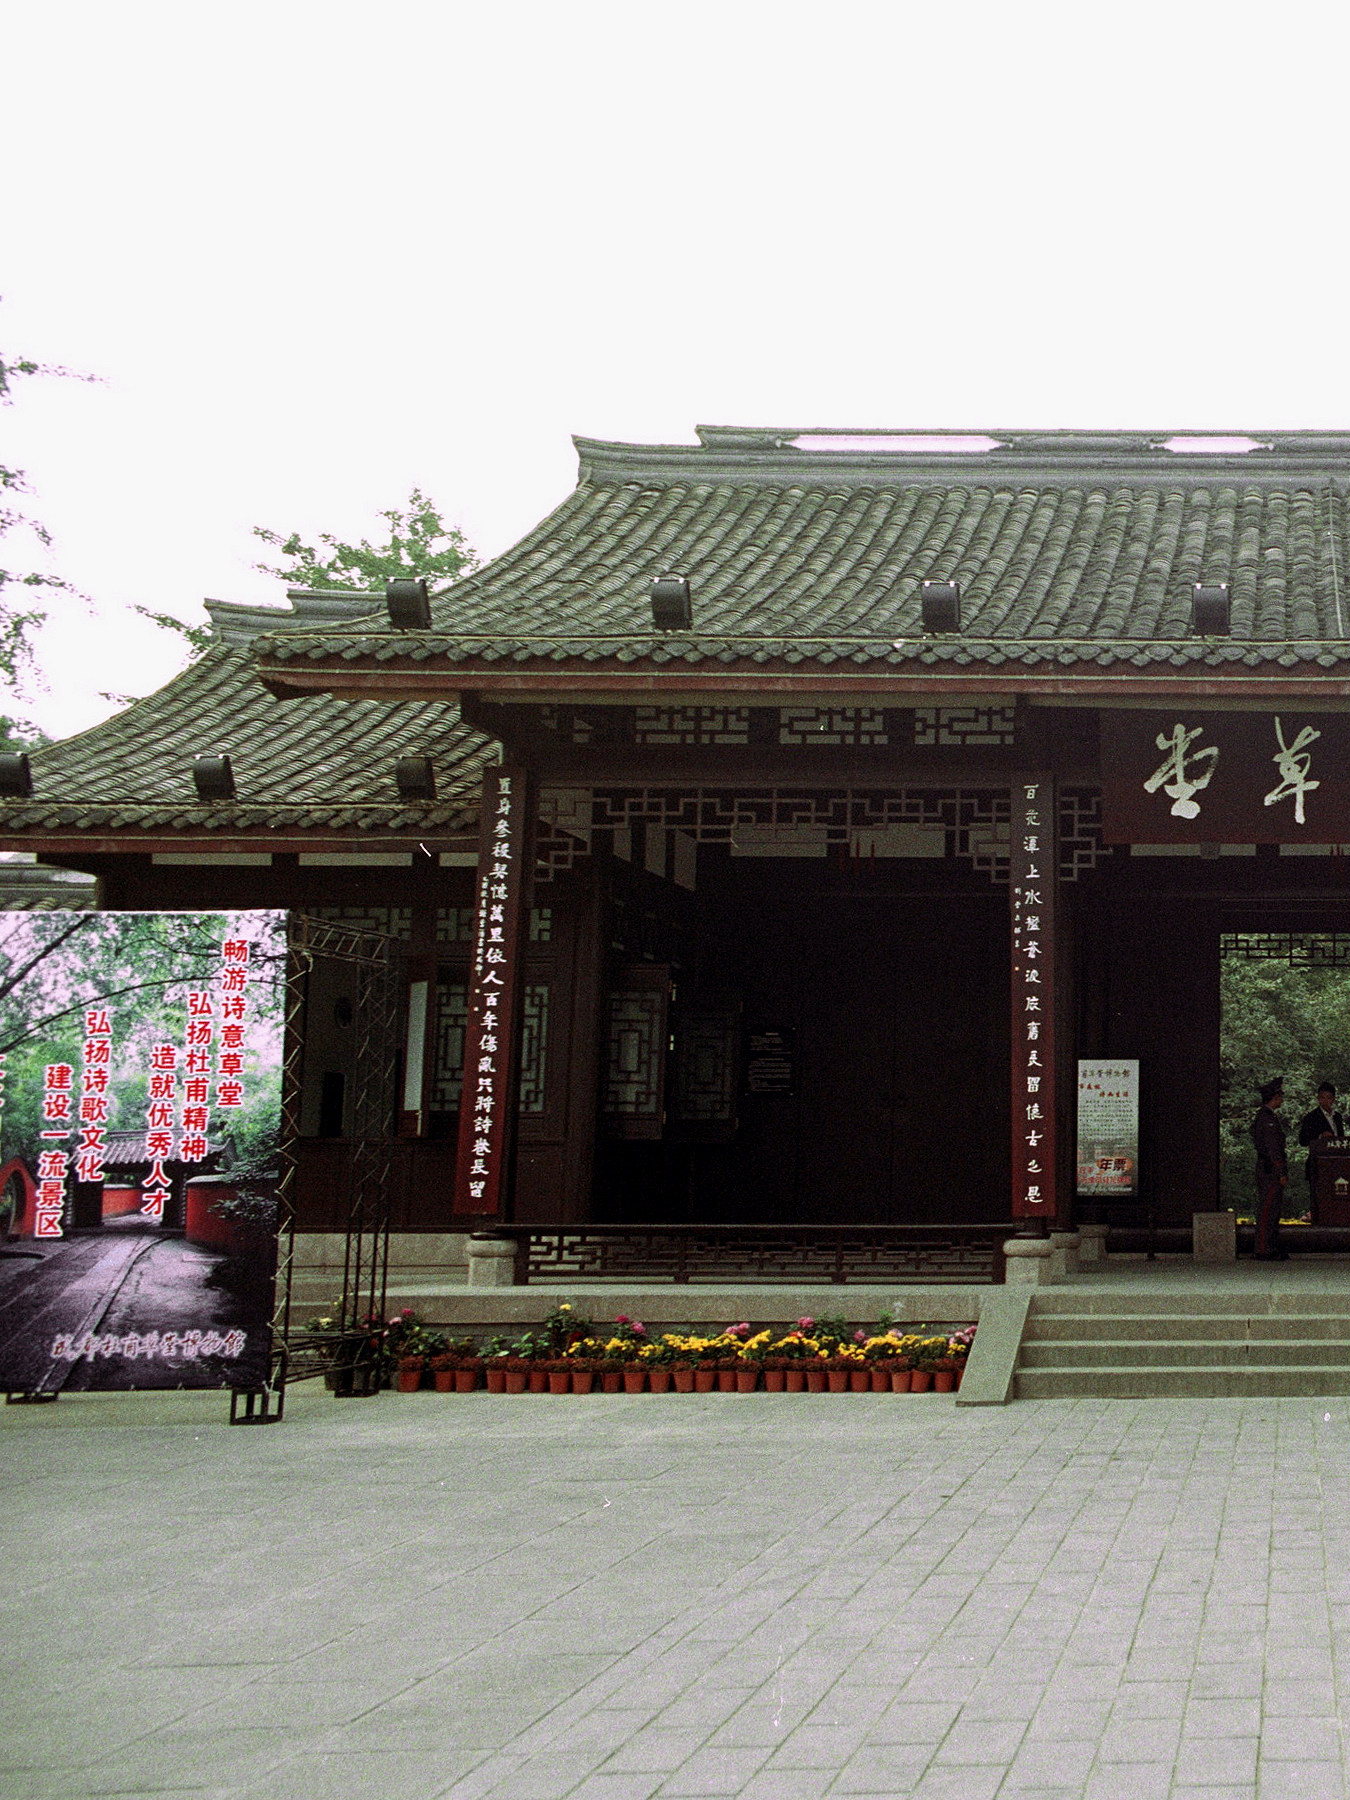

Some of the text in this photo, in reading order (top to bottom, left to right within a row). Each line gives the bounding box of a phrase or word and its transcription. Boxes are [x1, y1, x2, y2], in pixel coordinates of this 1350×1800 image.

[77, 1011, 112, 1182] 弘扬诗歌文化
[179, 991, 213, 1163] 弘扬杜甫精神
[216, 938, 249, 1108] 畅游诗意草堂
[34, 1064, 73, 1238] 建设一流景区
[140, 1045, 177, 1217] 造就优秀人才
[1099, 1158, 1127, 1171] 年票
